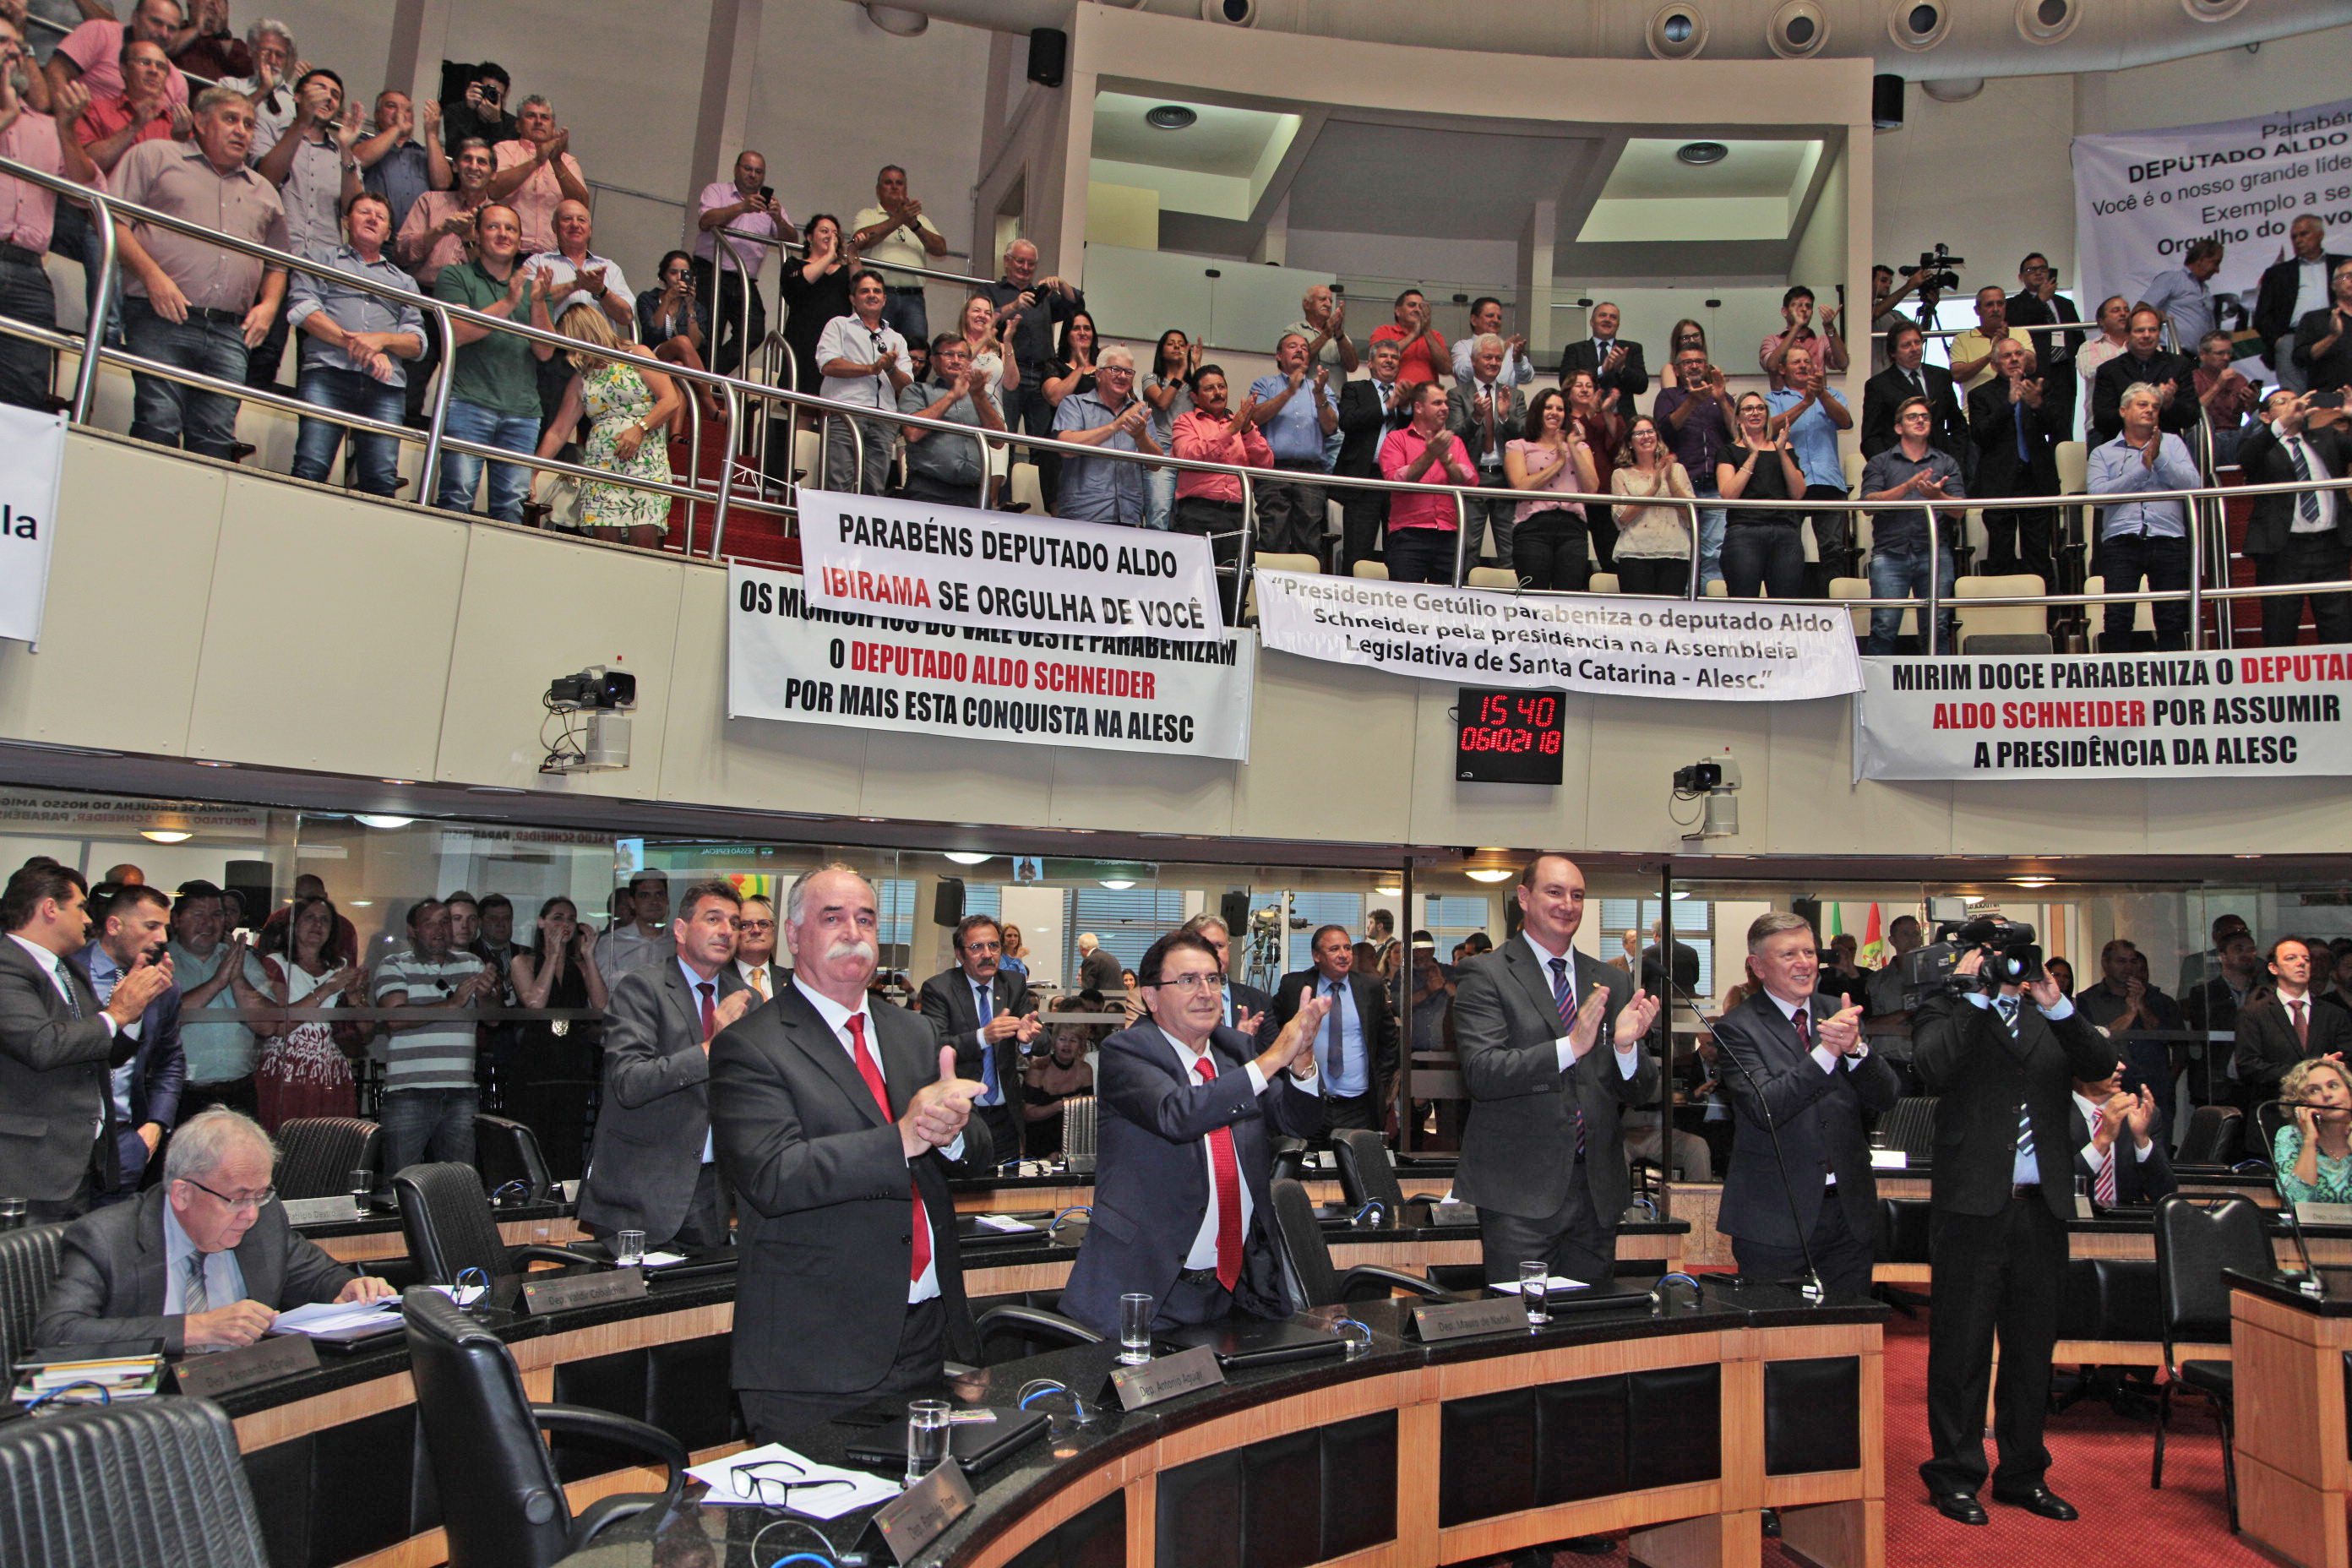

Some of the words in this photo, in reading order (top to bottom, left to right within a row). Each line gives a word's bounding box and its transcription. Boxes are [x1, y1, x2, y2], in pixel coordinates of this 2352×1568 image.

[2128, 146, 2266, 183] DEPUTADO
[2273, 133, 2348, 157] ALDO
[2092, 194, 2137, 216] Você
[2143, 192, 2155, 206] é
[2160, 191, 2172, 204] o
[2178, 178, 2235, 200] nosso
[2240, 163, 2310, 192] grande
[2202, 193, 2297, 224] Exemplo
[2304, 192, 2317, 205] a
[2257, 220, 2285, 237] do
[839, 513, 973, 558] PARABÉNS
[982, 531, 1108, 572] DEPUTADO
[1117, 546, 1177, 579] ALDO
[822, 566, 932, 608] IBIRAMA
[939, 580, 970, 615] SE
[977, 585, 1097, 623] ORGULHA
[1102, 597, 1134, 625] DE
[1139, 596, 1205, 629] VOCÊ
[1413, 593, 1497, 617] Getúlio
[1504, 604, 1632, 627] parabeniza
[1639, 614, 1653, 627] o
[1659, 608, 1772, 633] deputado
[1779, 612, 1834, 633] Aldo
[739, 580, 772, 614] OS
[1090, 636, 1238, 666] PARABENIZAM
[1314, 608, 1429, 635] Schneider
[1436, 623, 1485, 640] pela
[1491, 628, 1624, 651] presidência
[1630, 640, 1658, 654] na
[1665, 639, 1798, 659] Assembleia
[830, 638, 845, 669] O
[852, 640, 967, 682] DEPUTADO
[972, 656, 1028, 689] ALDO
[1035, 661, 1156, 700] SCHNEIDER
[1347, 634, 1467, 668] Legislativa
[1474, 649, 1503, 672] de
[1509, 653, 1571, 678] Santa
[1578, 659, 1676, 687] Catarina
[1892, 664, 1972, 690] MIRIM
[1979, 662, 2044, 689] DOCE
[2051, 660, 2210, 689] PARABENIZA
[2216, 658, 2234, 685] O
[785, 678, 833, 713] POR
[840, 683, 899, 719] MAIS
[906, 691, 957, 724] ESTA
[962, 696, 1088, 736] CONQUISTA
[1095, 708, 1123, 738] NA
[1127, 711, 1194, 743] ALESC
[1933, 702, 1995, 729] ALDO
[2002, 700, 2146, 729] SCHNEIDER
[2153, 699, 2206, 726] POR
[2213, 694, 2340, 724] ASSUMIR
[1974, 742, 1990, 768] A
[1996, 735, 2167, 768] PRESIDÊNCIA
[2172, 738, 2210, 765] DA
[2215, 736, 2297, 764] ALESC
[1140, 1386, 1155, 1397] Dep.
